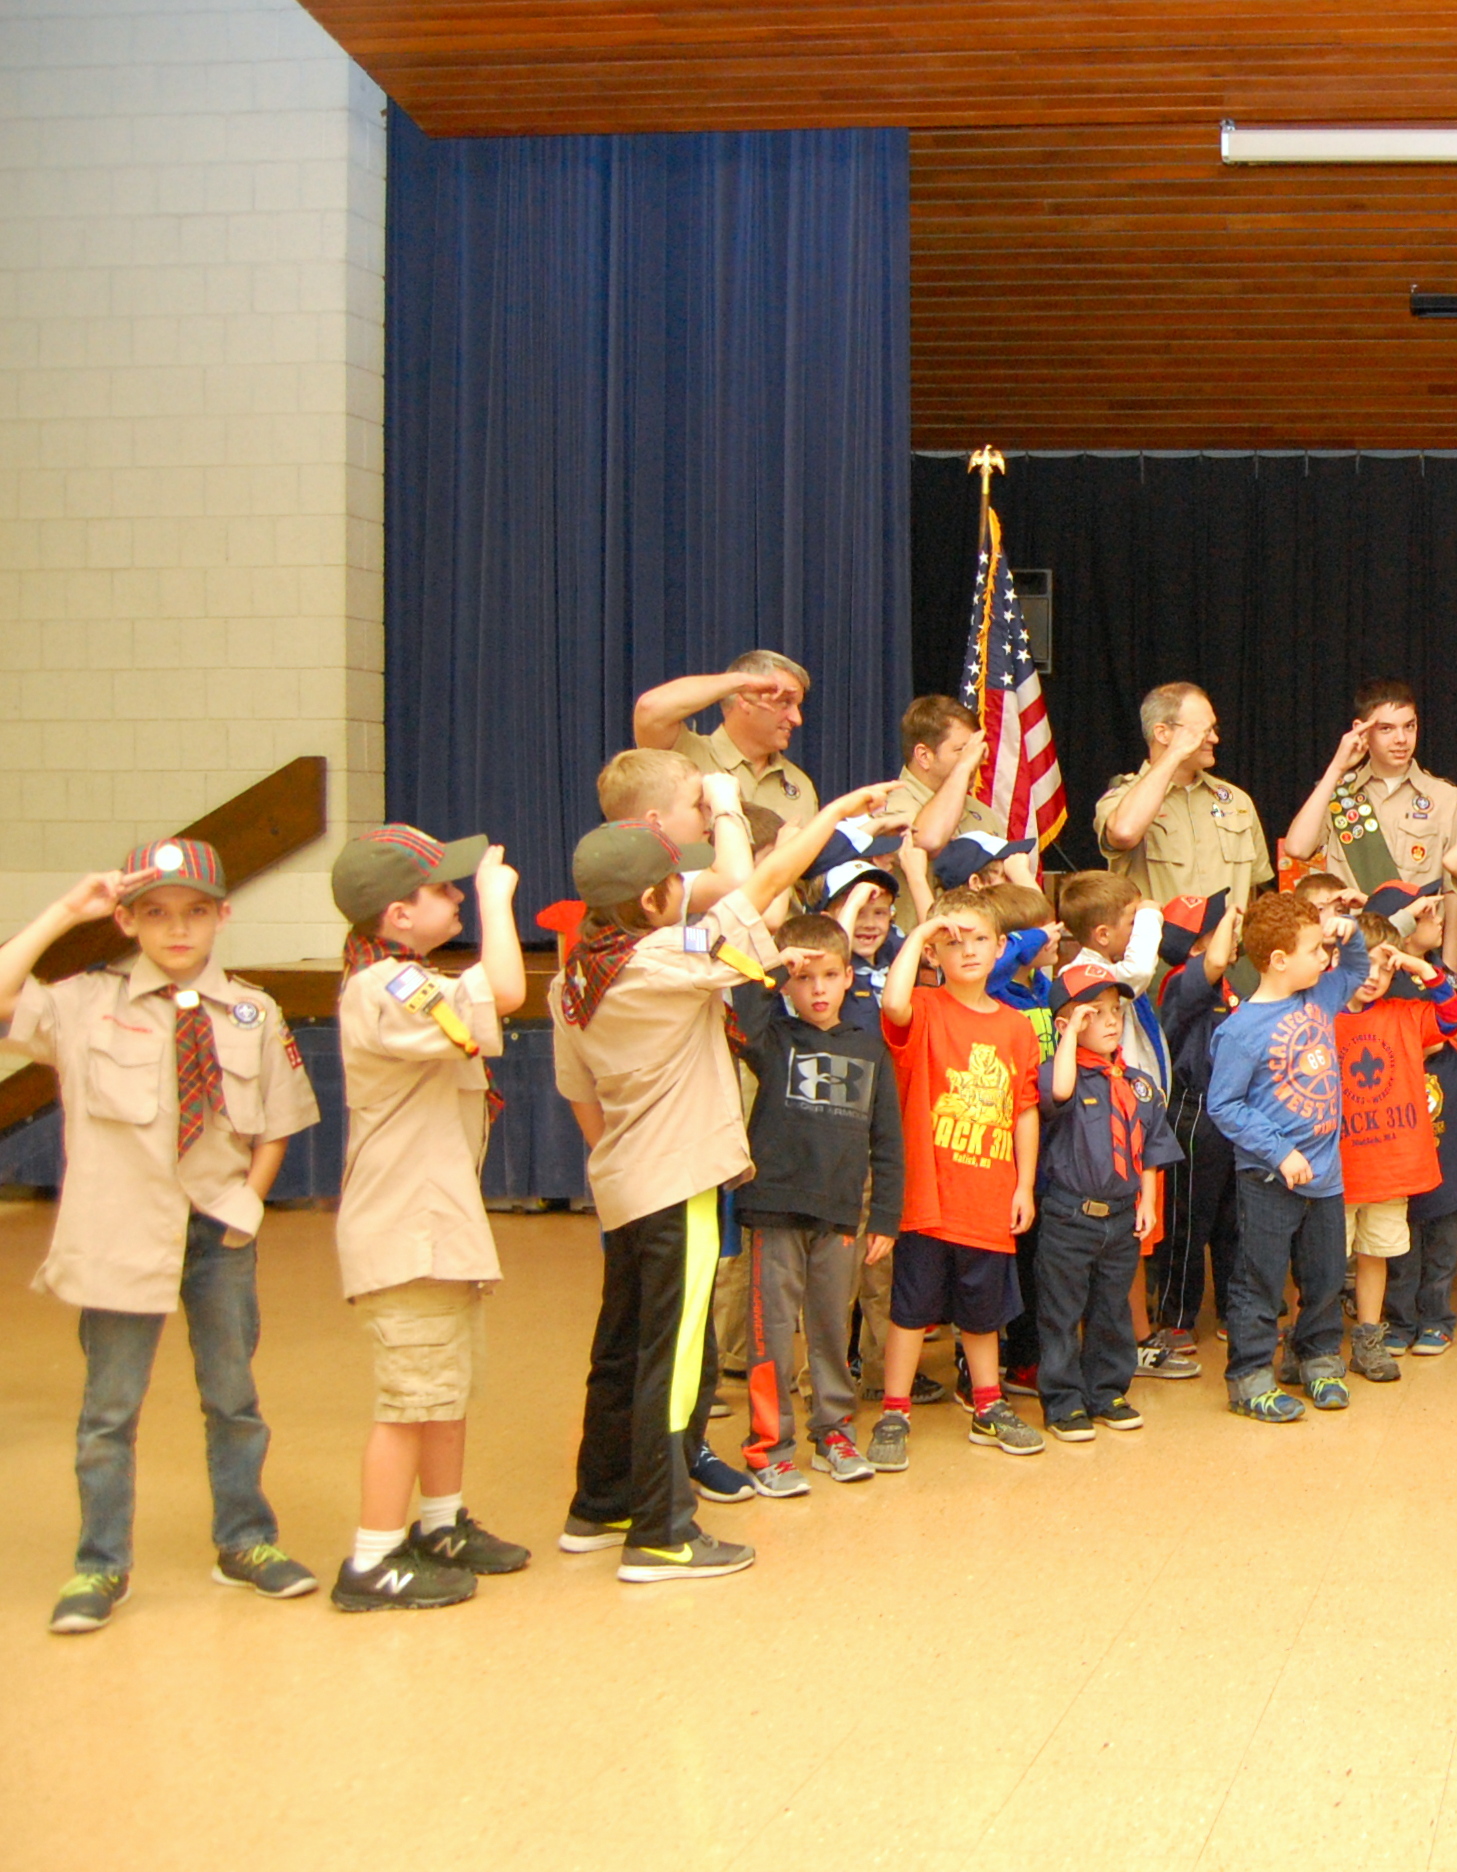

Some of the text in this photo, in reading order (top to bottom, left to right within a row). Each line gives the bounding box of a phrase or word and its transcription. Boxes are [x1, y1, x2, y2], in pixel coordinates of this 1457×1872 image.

[1307, 1049, 1326, 1070] 86
[1274, 1082, 1326, 1121] WEST
[1341, 1110, 1380, 1140] ACK
[1386, 1102, 1417, 1129] 310
[1137, 1347, 1161, 1369] KE
[434, 1536, 466, 1559] N
[375, 1568, 414, 1595] N
